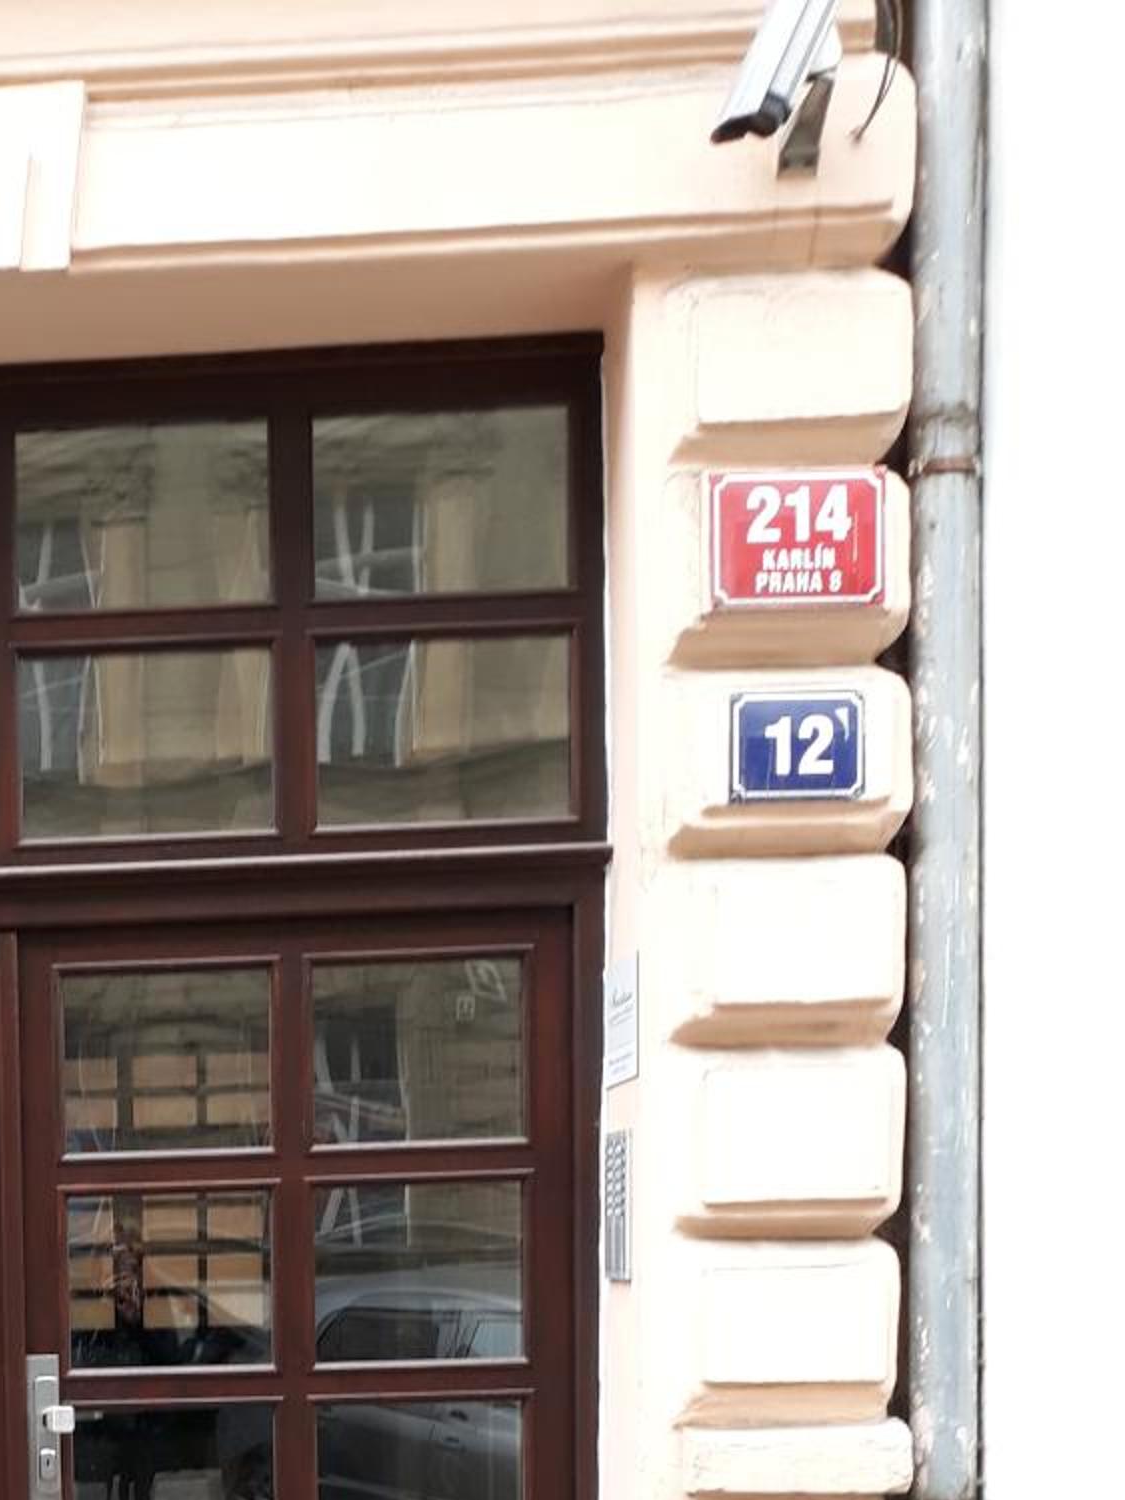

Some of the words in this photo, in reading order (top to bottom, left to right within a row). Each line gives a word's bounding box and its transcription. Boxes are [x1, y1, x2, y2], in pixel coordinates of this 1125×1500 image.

[746, 484, 853, 544] 214
[762, 543, 836, 571] KARLÍN
[755, 570, 824, 594] PRAHA
[828, 569, 844, 593] 8
[764, 714, 835, 776] 12
